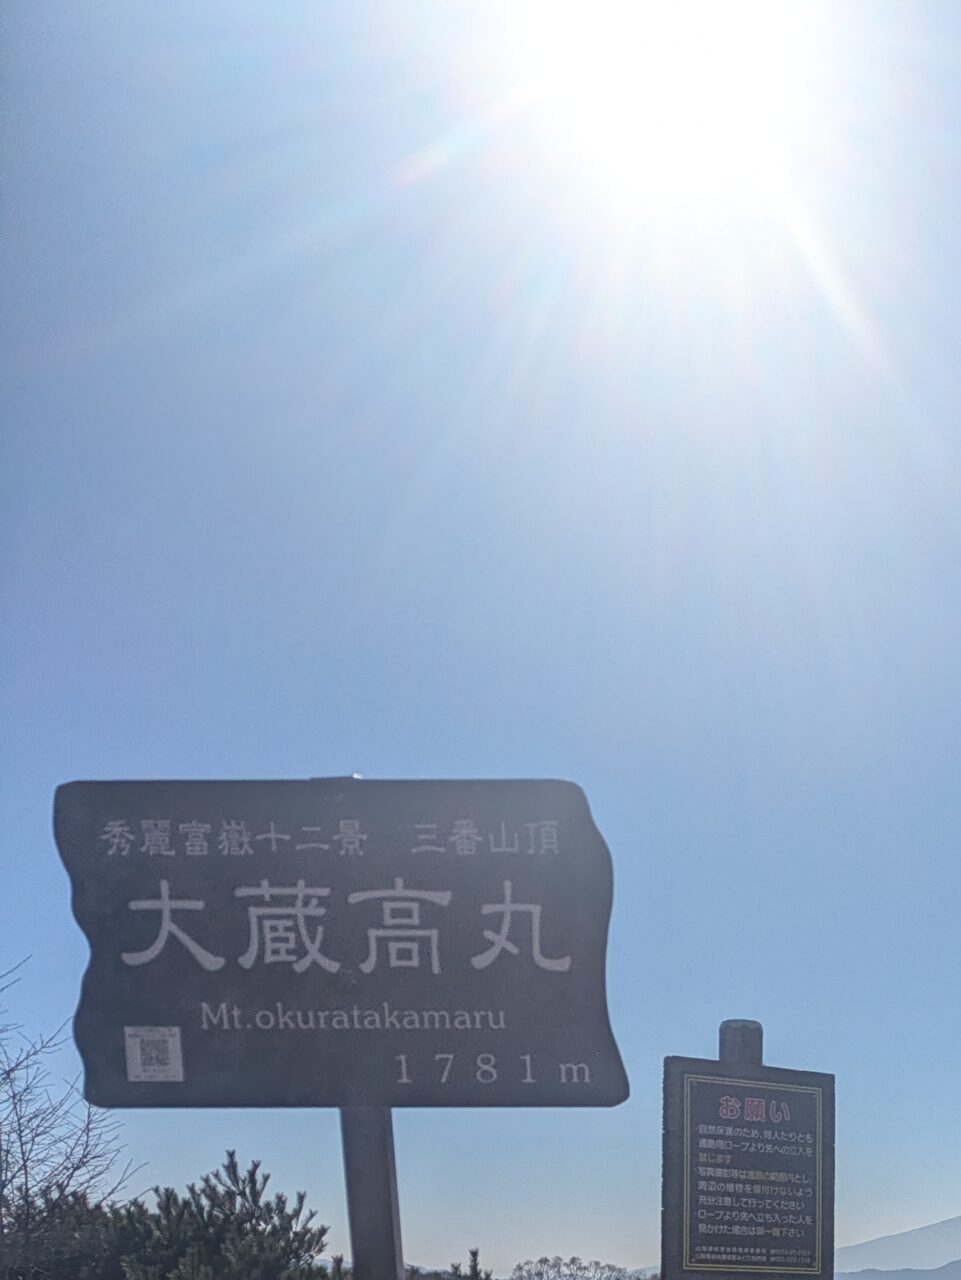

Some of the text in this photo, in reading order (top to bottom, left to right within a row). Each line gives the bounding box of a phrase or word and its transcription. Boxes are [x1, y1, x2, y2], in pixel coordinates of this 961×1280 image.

[101, 820, 560, 857] 秀麗富嶽十二景 三番山頂
[121, 878, 571, 974] 大蔵高丸
[200, 1003, 507, 1031] Mt.okuratakamaru
[719, 1095, 791, 1123] お願い
